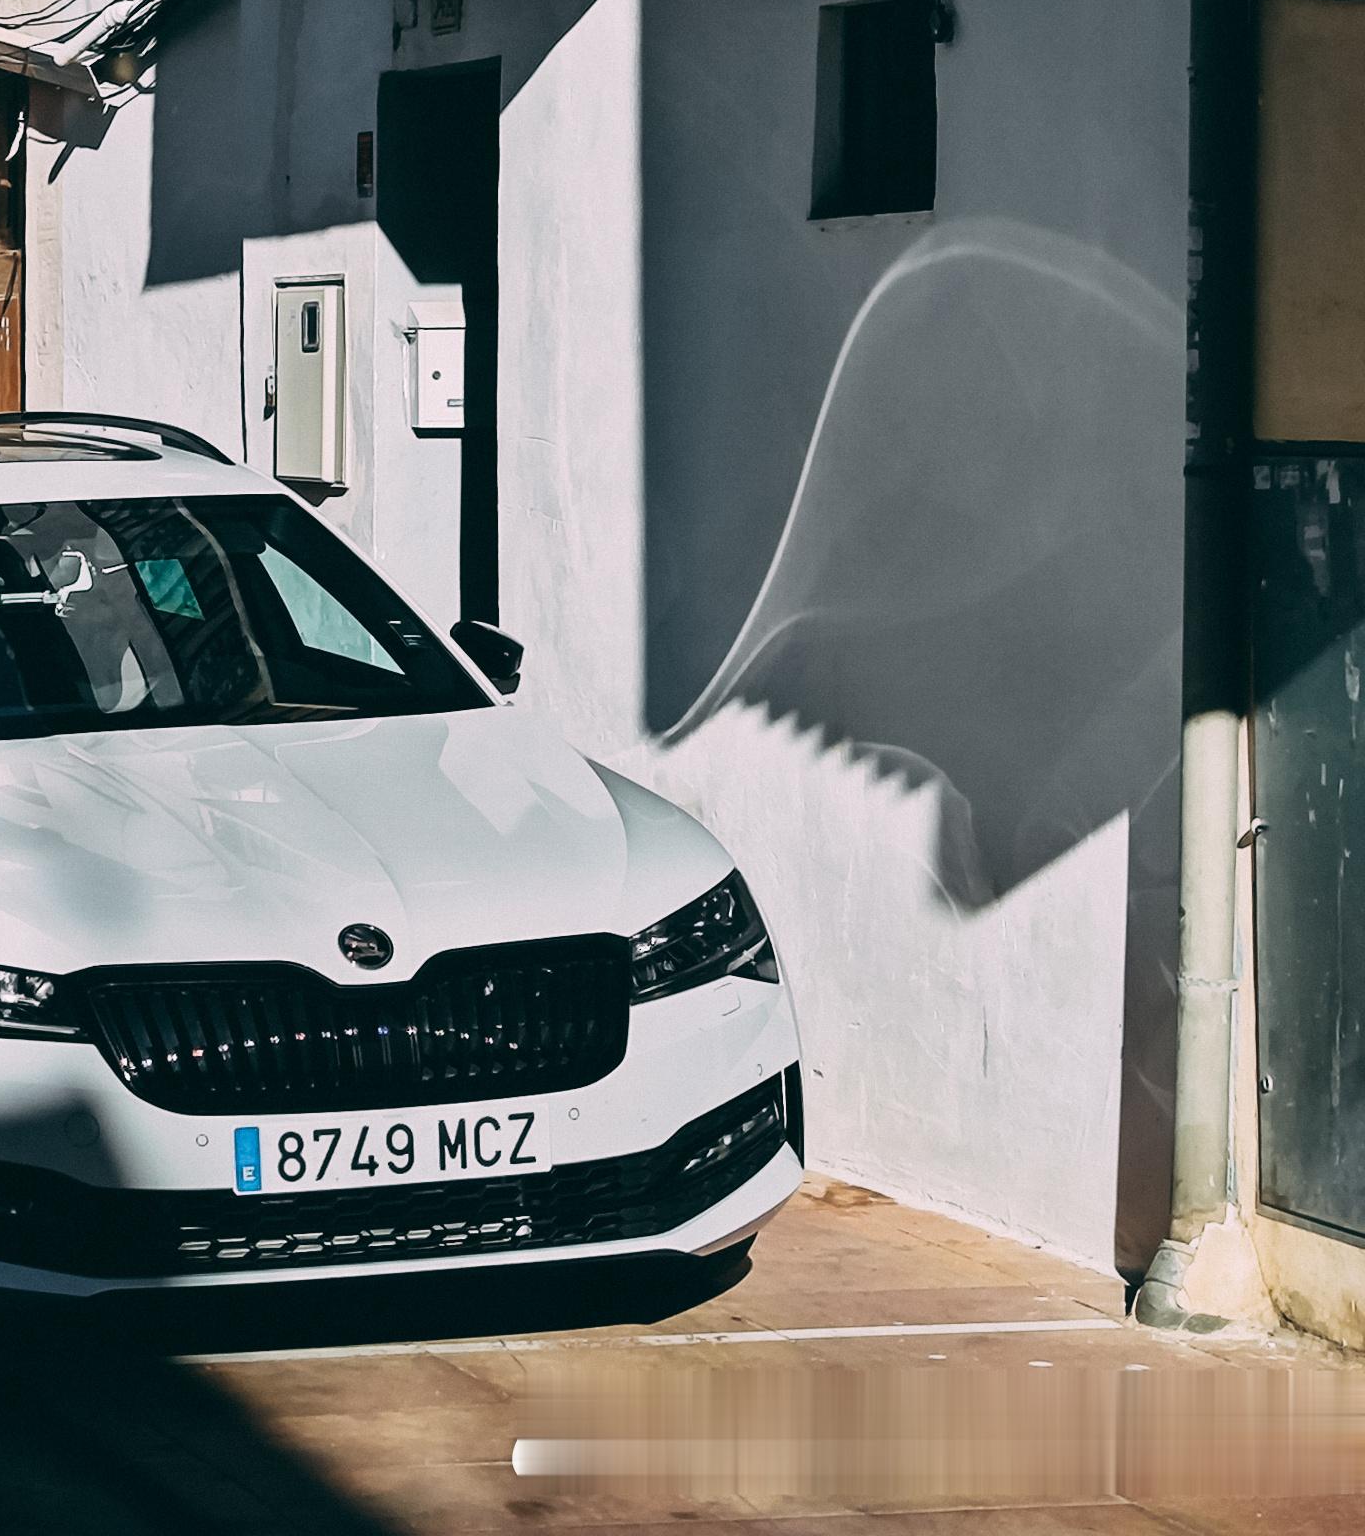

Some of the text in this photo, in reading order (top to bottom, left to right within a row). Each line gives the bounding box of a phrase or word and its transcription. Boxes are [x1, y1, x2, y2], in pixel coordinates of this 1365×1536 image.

[277, 1112, 537, 1182] 8749 MCZ
[242, 1166, 257, 1182] E
